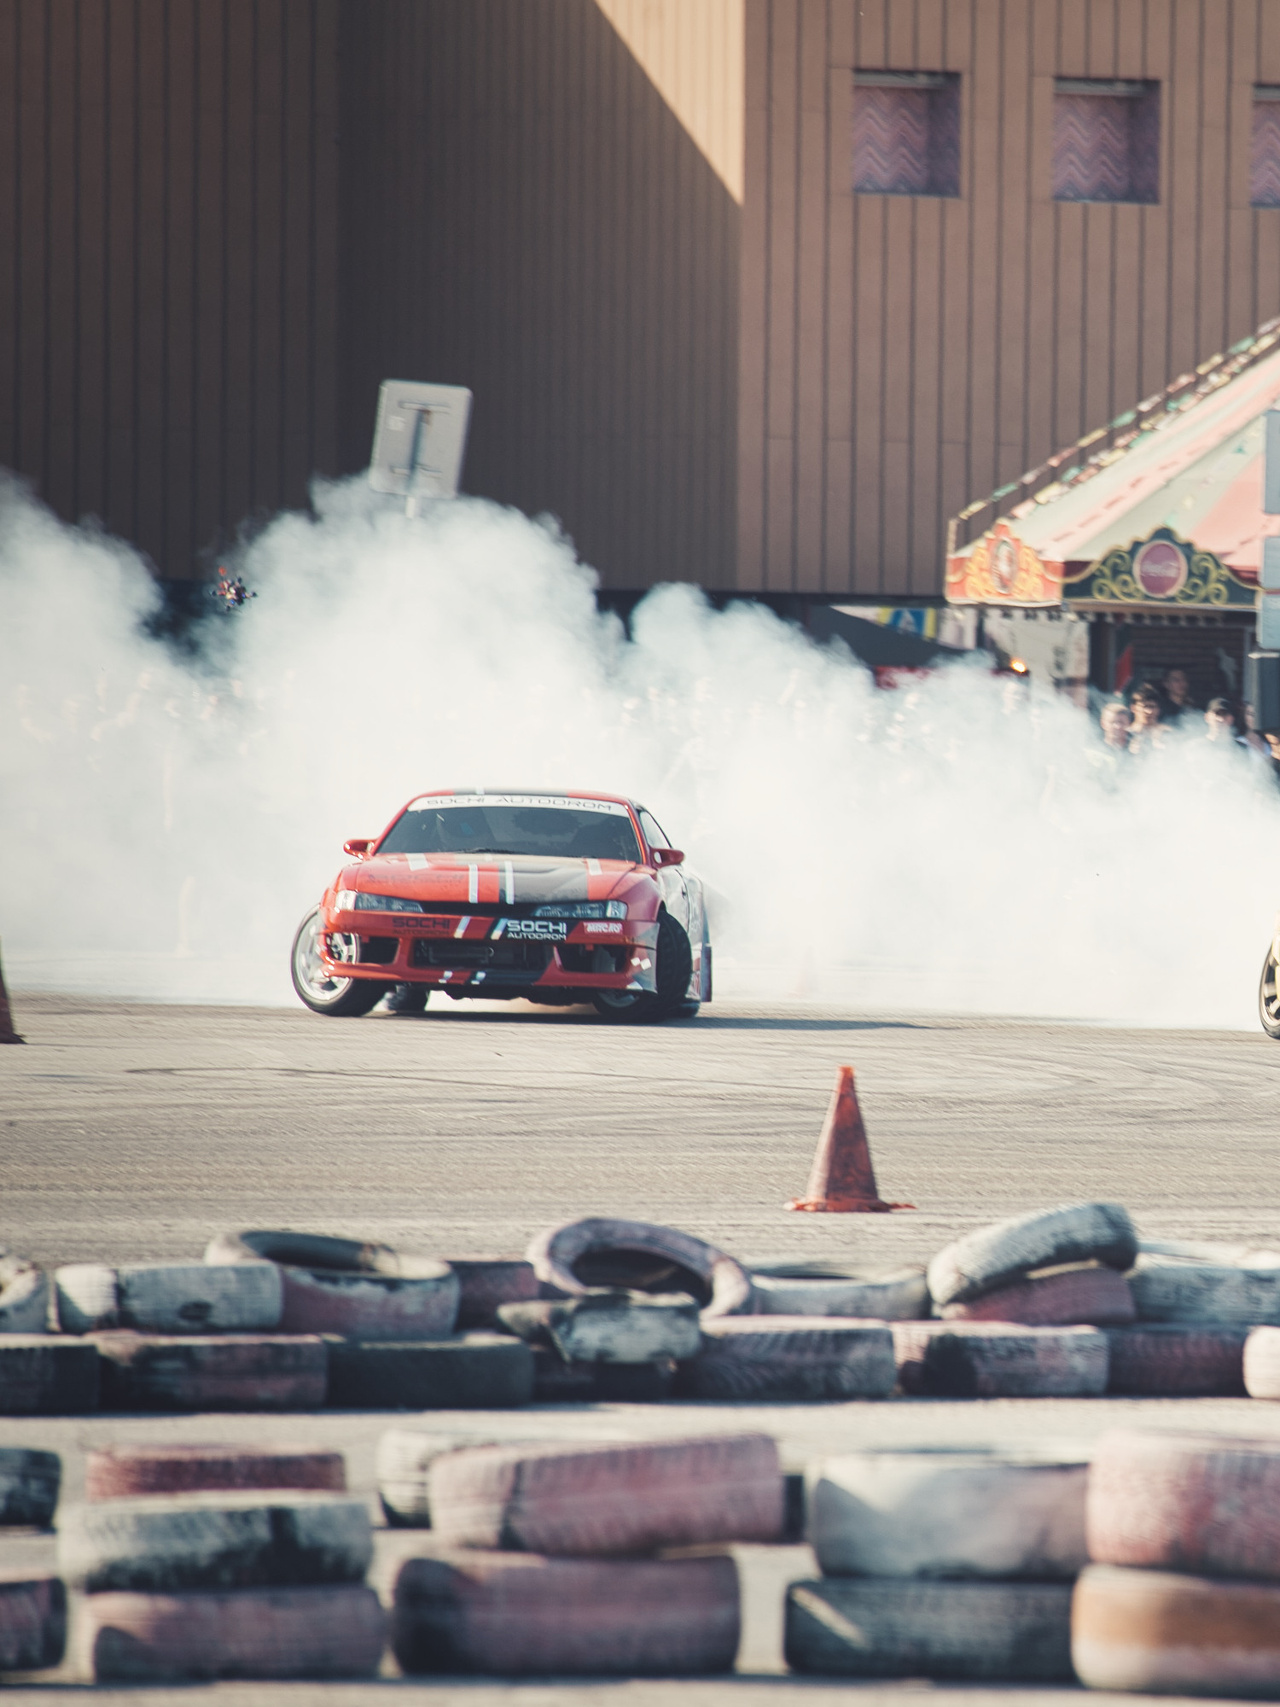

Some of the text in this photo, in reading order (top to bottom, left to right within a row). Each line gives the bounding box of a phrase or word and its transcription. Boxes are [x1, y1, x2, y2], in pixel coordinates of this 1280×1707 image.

[497, 796, 612, 811] AUTODROM
[392, 916, 450, 929] SOCHI
[507, 919, 567, 933] SOCHI
[507, 932, 567, 941] AUTODROM
